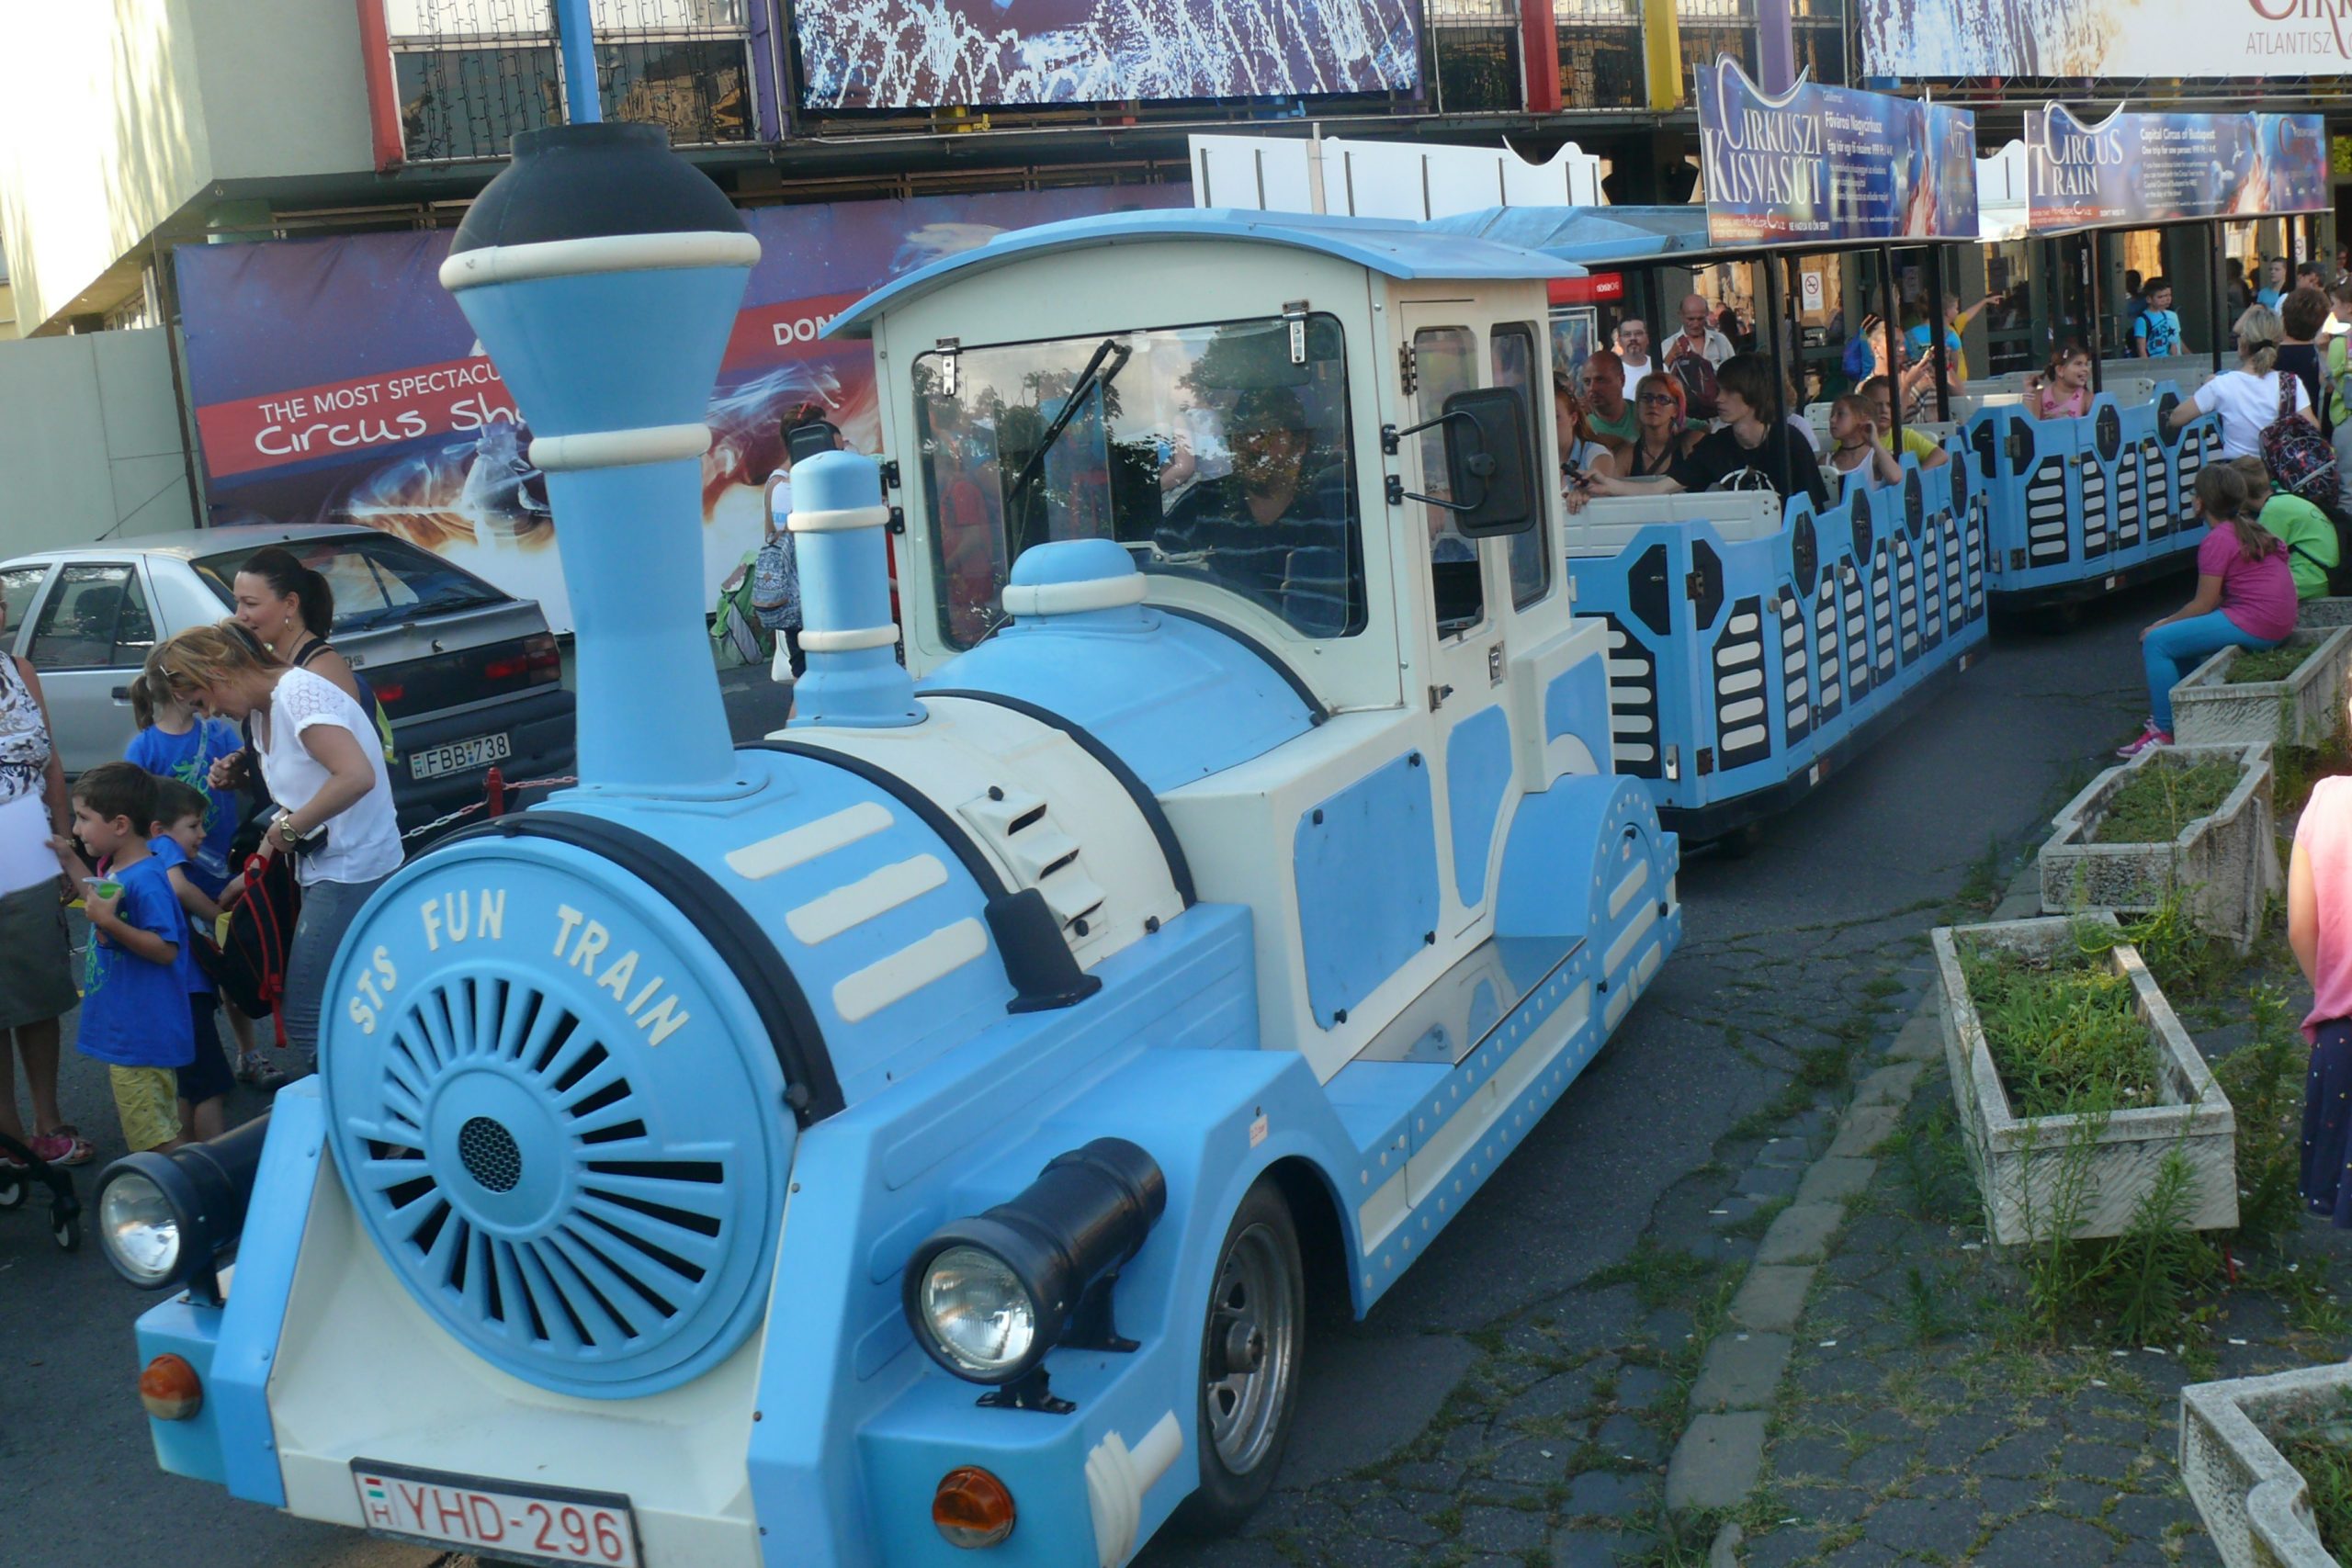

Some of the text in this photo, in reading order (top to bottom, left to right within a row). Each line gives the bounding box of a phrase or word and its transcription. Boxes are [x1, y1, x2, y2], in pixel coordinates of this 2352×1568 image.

[2245, 31, 2332, 54] ATLANTISZ
[1716, 59, 1822, 154] CIRKUSZI
[2043, 100, 2124, 164] CIRCUS
[2140, 128, 2216, 142] Capital Circus of Budapest
[1702, 128, 1822, 204] KISVASÚT
[2029, 144, 2098, 196] TRAIN
[773, 312, 842, 345] DON
[258, 398, 308, 423] THE
[313, 384, 379, 413] MOST
[254, 410, 427, 455] Circus
[349, 888, 690, 1047] STS FUN TRAIN
[371, 1483, 623, 1562] H YHD-296
